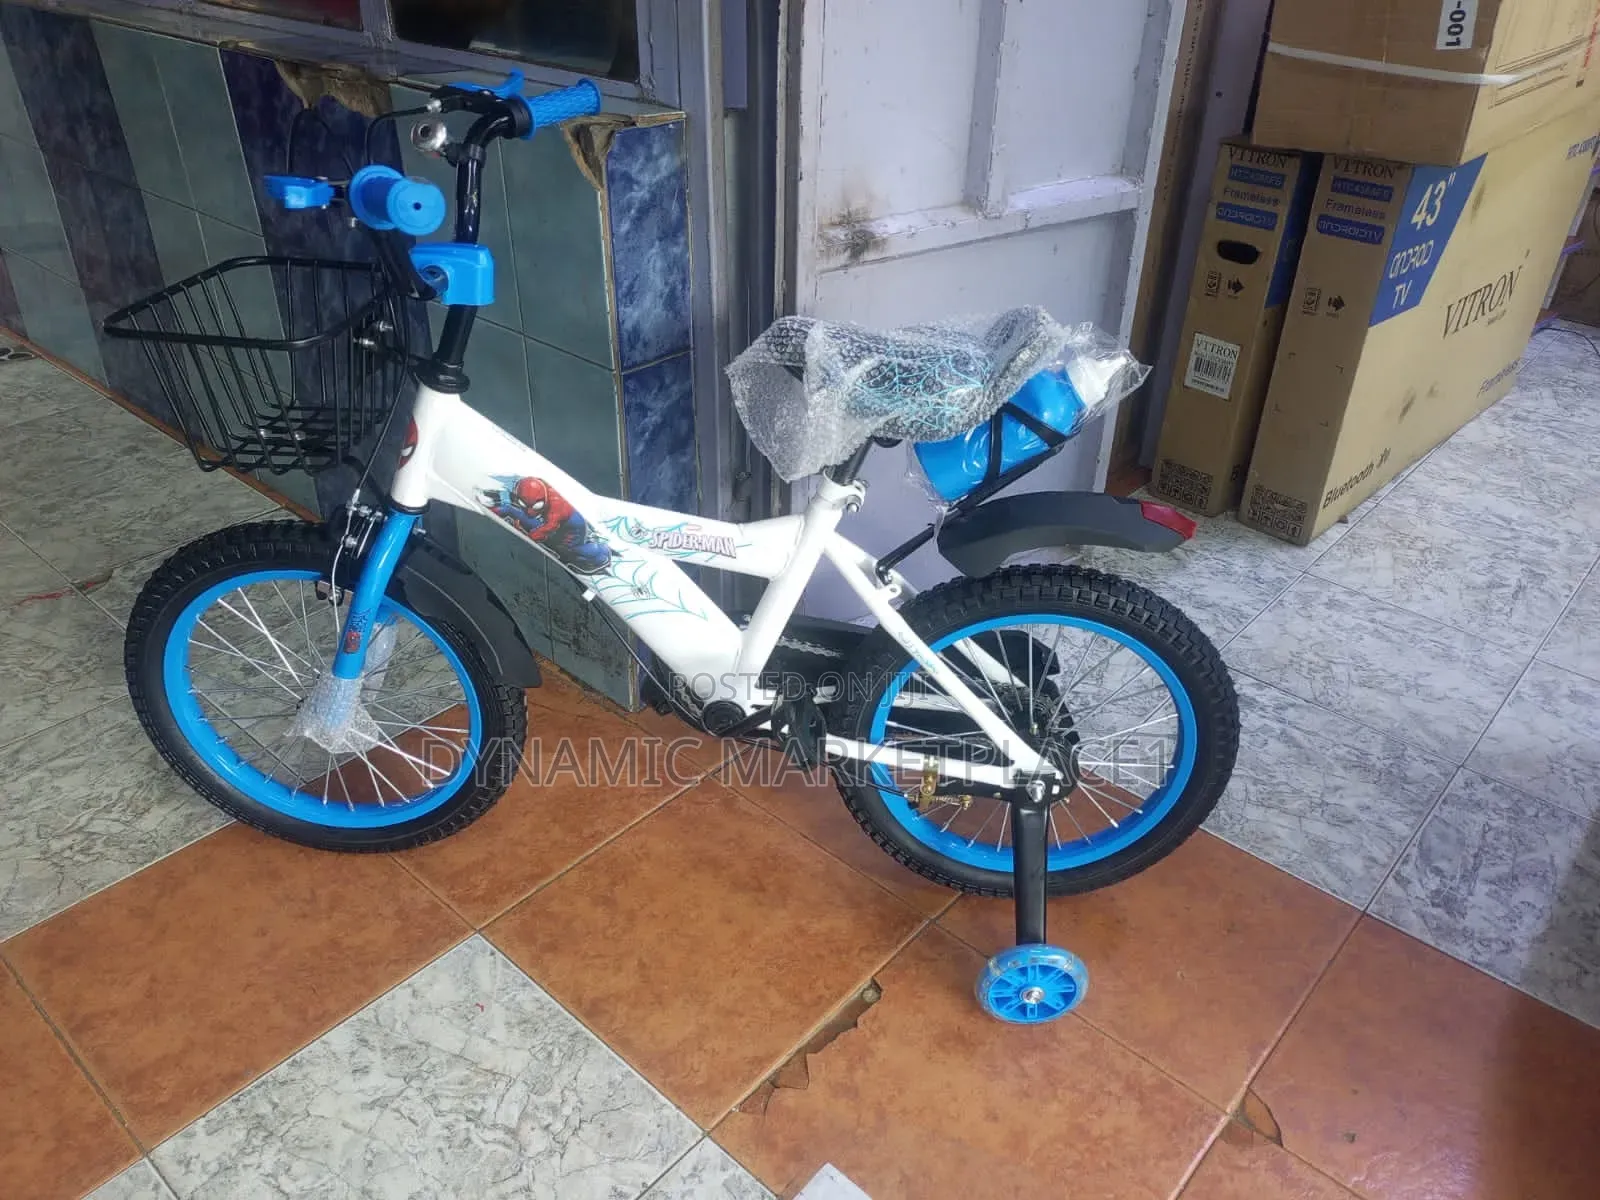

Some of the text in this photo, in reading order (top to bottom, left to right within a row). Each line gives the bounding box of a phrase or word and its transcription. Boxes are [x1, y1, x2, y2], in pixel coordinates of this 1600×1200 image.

[1333, 154, 1396, 179] VITRON
[1411, 171, 1456, 231] 43"
[1392, 279, 1413, 310] TV
[1443, 264, 1524, 340] VITRON
[1196, 338, 1238, 360] VITRON
[1322, 461, 1375, 510] Bluetooth
